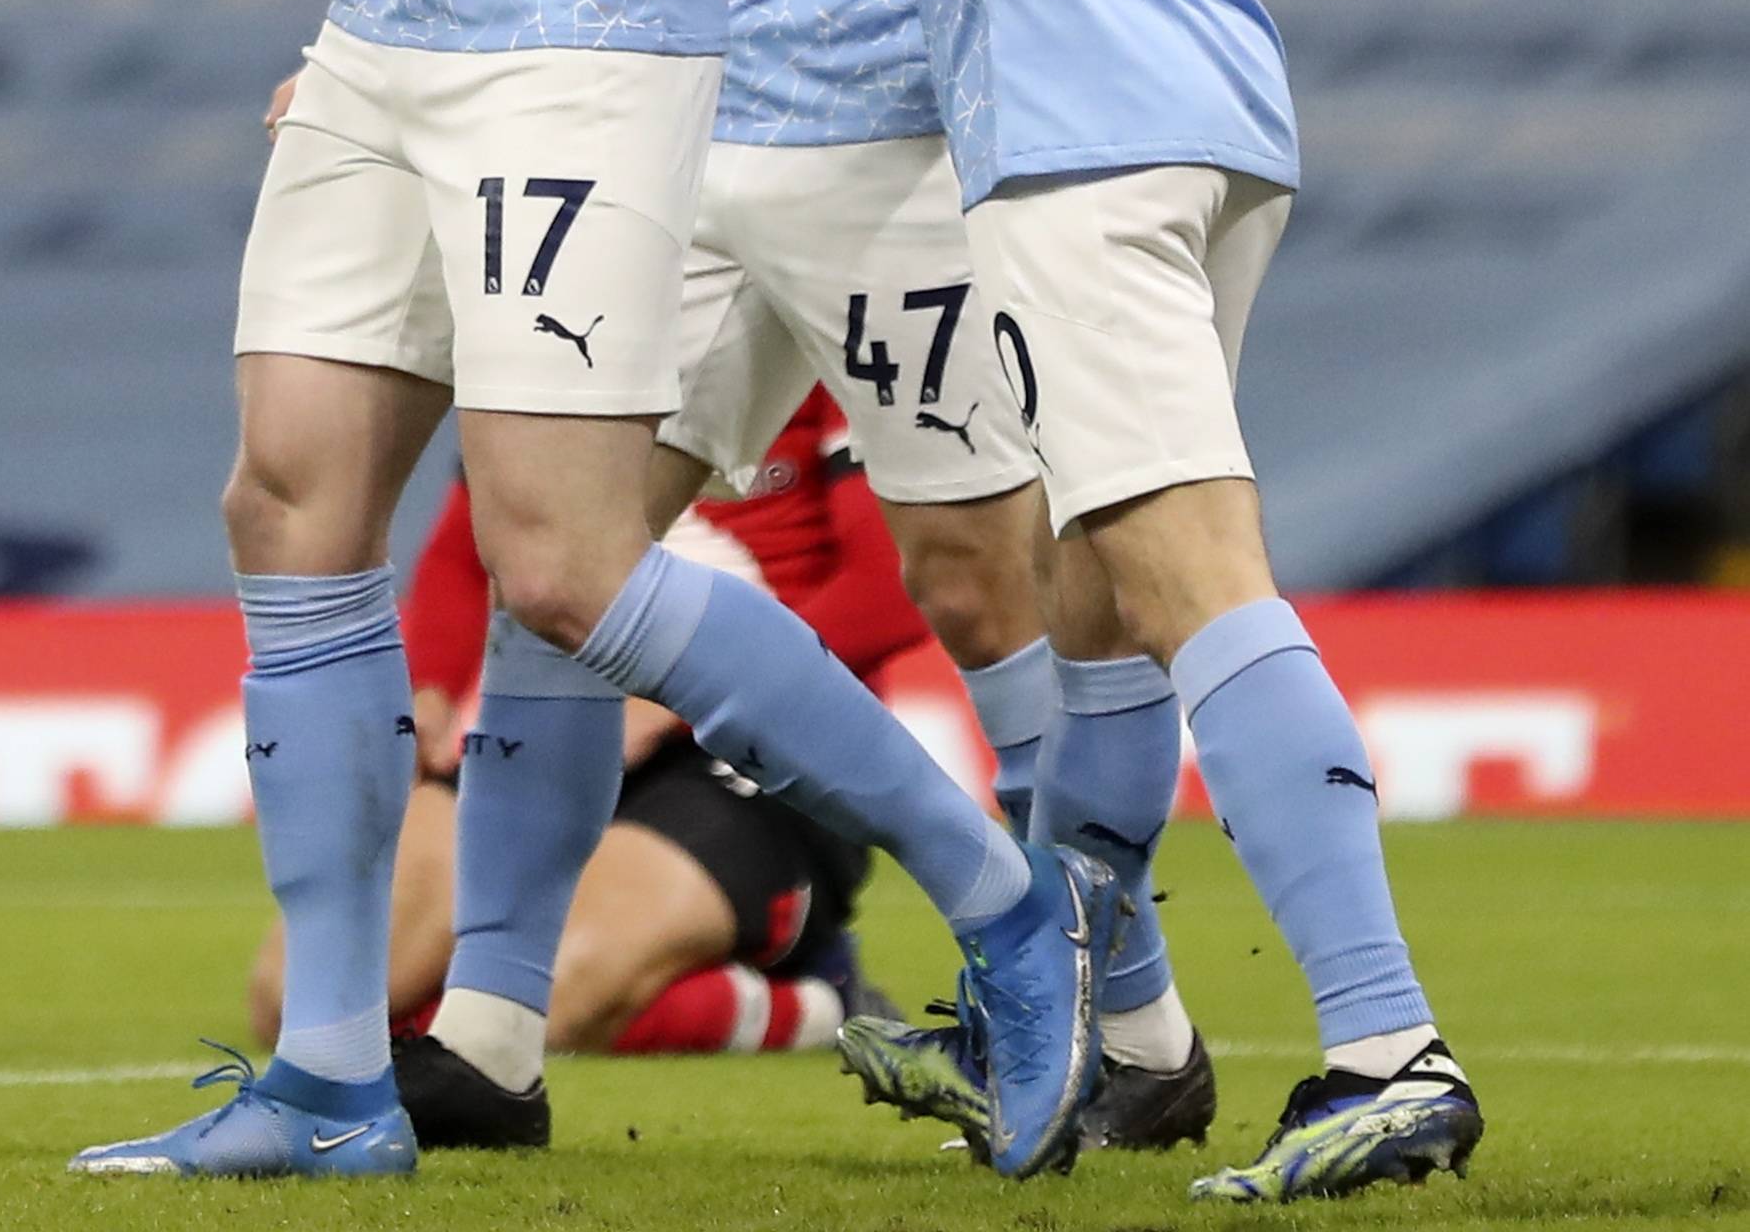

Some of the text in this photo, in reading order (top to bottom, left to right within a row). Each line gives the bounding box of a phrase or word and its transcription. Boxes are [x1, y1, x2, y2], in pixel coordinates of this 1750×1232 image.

[476, 176, 597, 297] 17
[845, 281, 972, 407] 47
[993, 310, 1038, 429] 0
[461, 733, 524, 759] ITY
